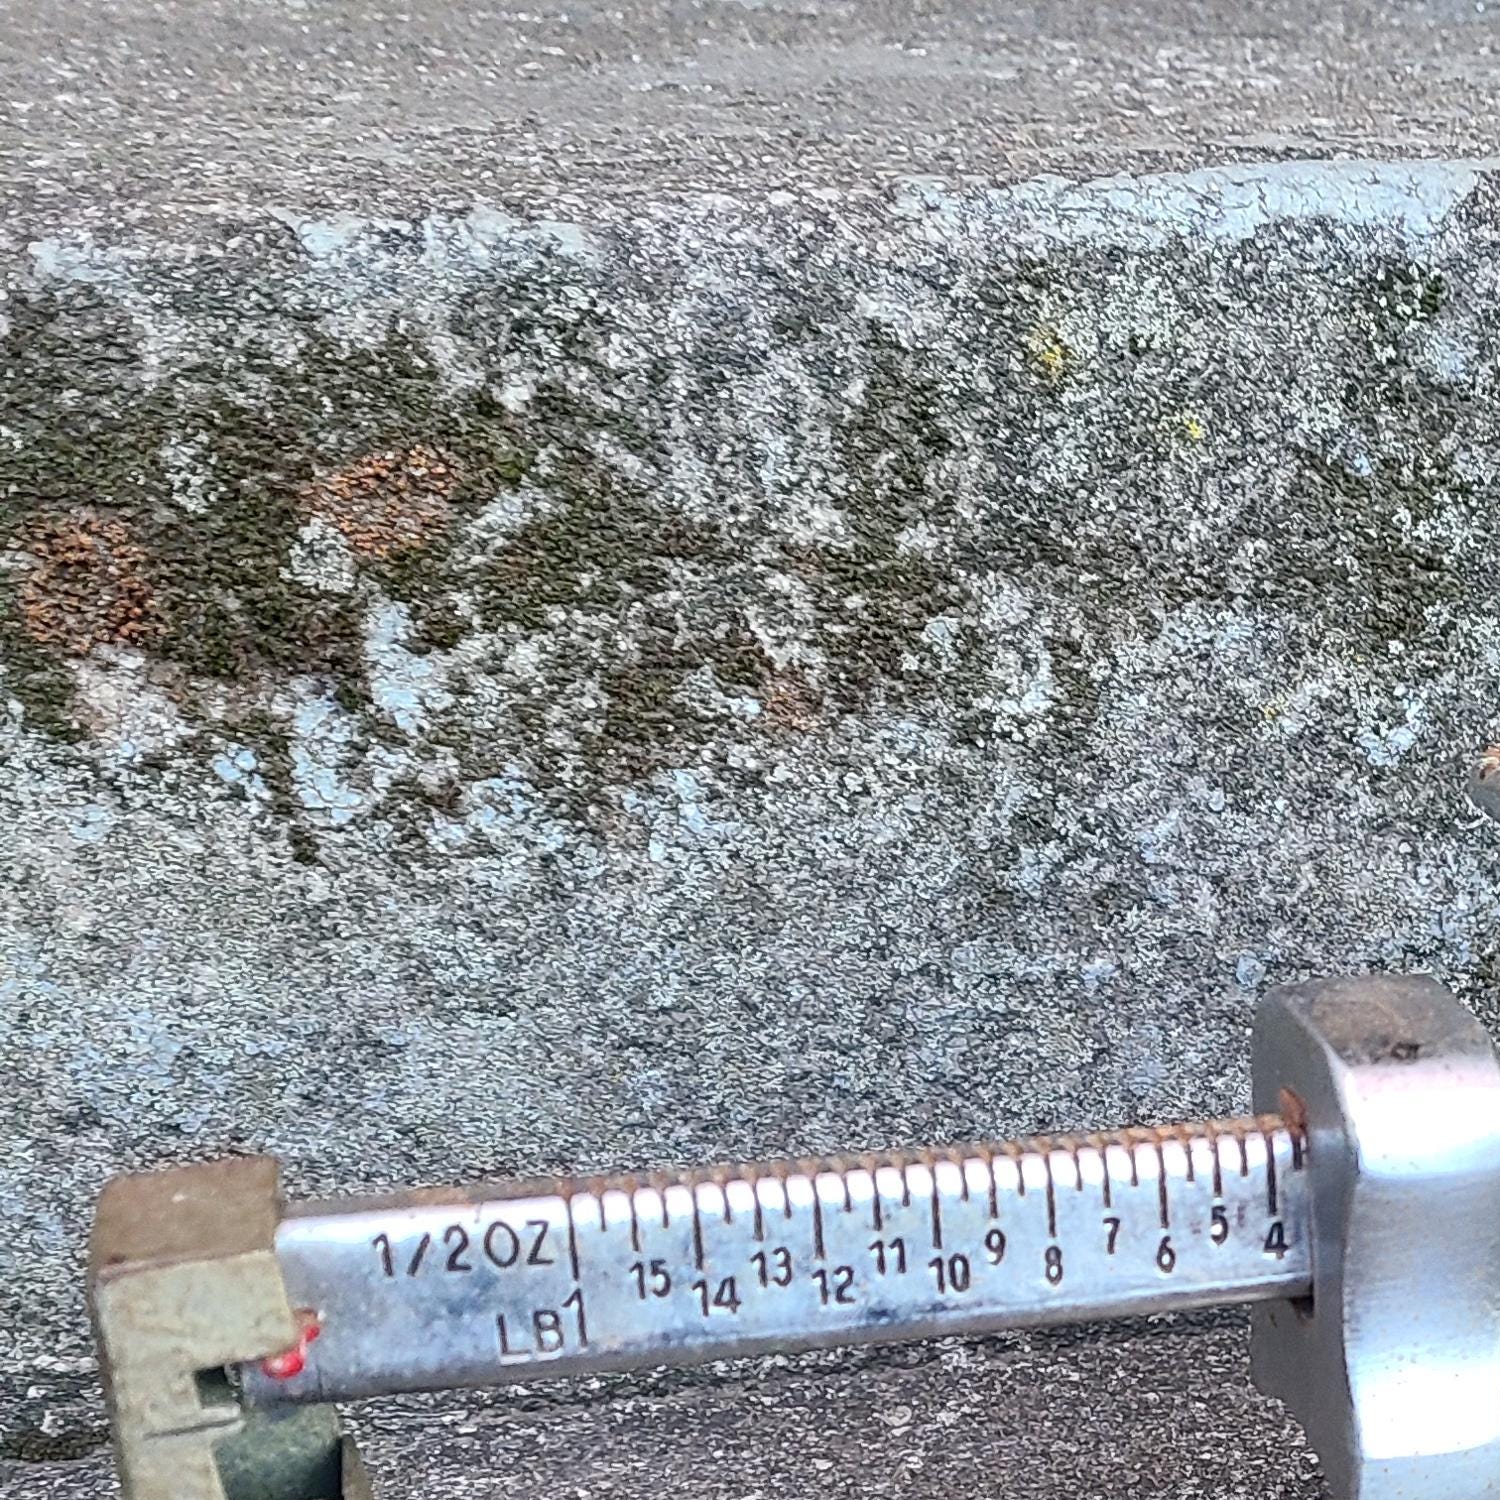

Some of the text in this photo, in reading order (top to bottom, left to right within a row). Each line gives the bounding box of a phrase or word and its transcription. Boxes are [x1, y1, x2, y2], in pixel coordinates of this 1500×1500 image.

[498, 1309, 564, 1357] LB
[692, 1276, 742, 1317] 14
[811, 1265, 856, 1305] 12
[928, 1253, 970, 1294] 10
[1044, 1245, 1063, 1286] 8
[1156, 1236, 1176, 1274] 6
[1263, 1222, 1288, 1260] 4
[628, 1258, 672, 1300] 15
[749, 1246, 793, 1287] 13
[869, 1237, 907, 1275] 11
[984, 1228, 1006, 1266] 9
[1102, 1216, 1121, 1255] 7
[1210, 1204, 1229, 1246] 5
